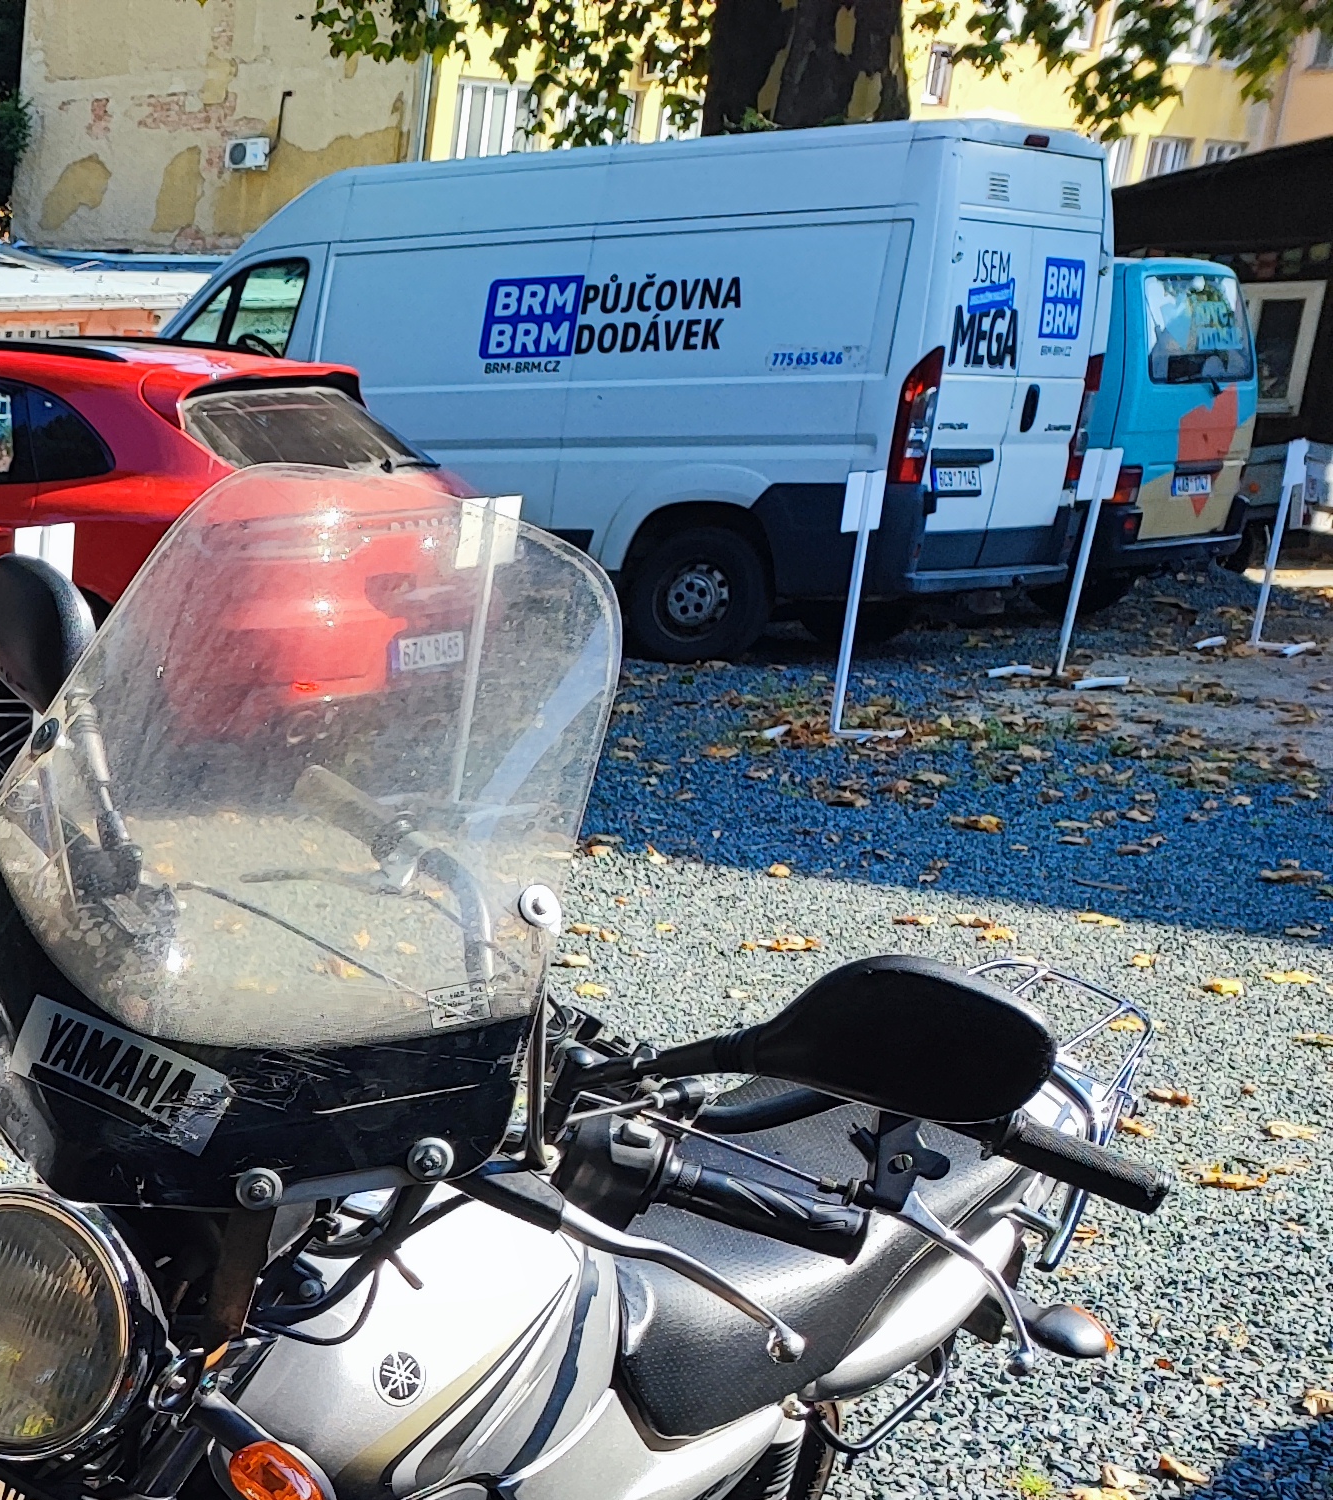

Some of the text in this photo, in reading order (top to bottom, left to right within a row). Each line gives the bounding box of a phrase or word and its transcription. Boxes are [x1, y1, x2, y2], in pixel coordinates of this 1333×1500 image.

[973, 250, 1011, 286] JSEM
[1046, 265, 1082, 299] BRM
[493, 273, 741, 317] BRM PŮJČOVNA
[487, 313, 724, 355] BRM DODÁVEK
[948, 305, 1018, 370] MEGA
[1042, 303, 1079, 336] BRM
[484, 360, 560, 374] BRM-BRM.CZ
[771, 351, 843, 366] 775 635 426
[40, 1013, 196, 1121] YAMAHA
